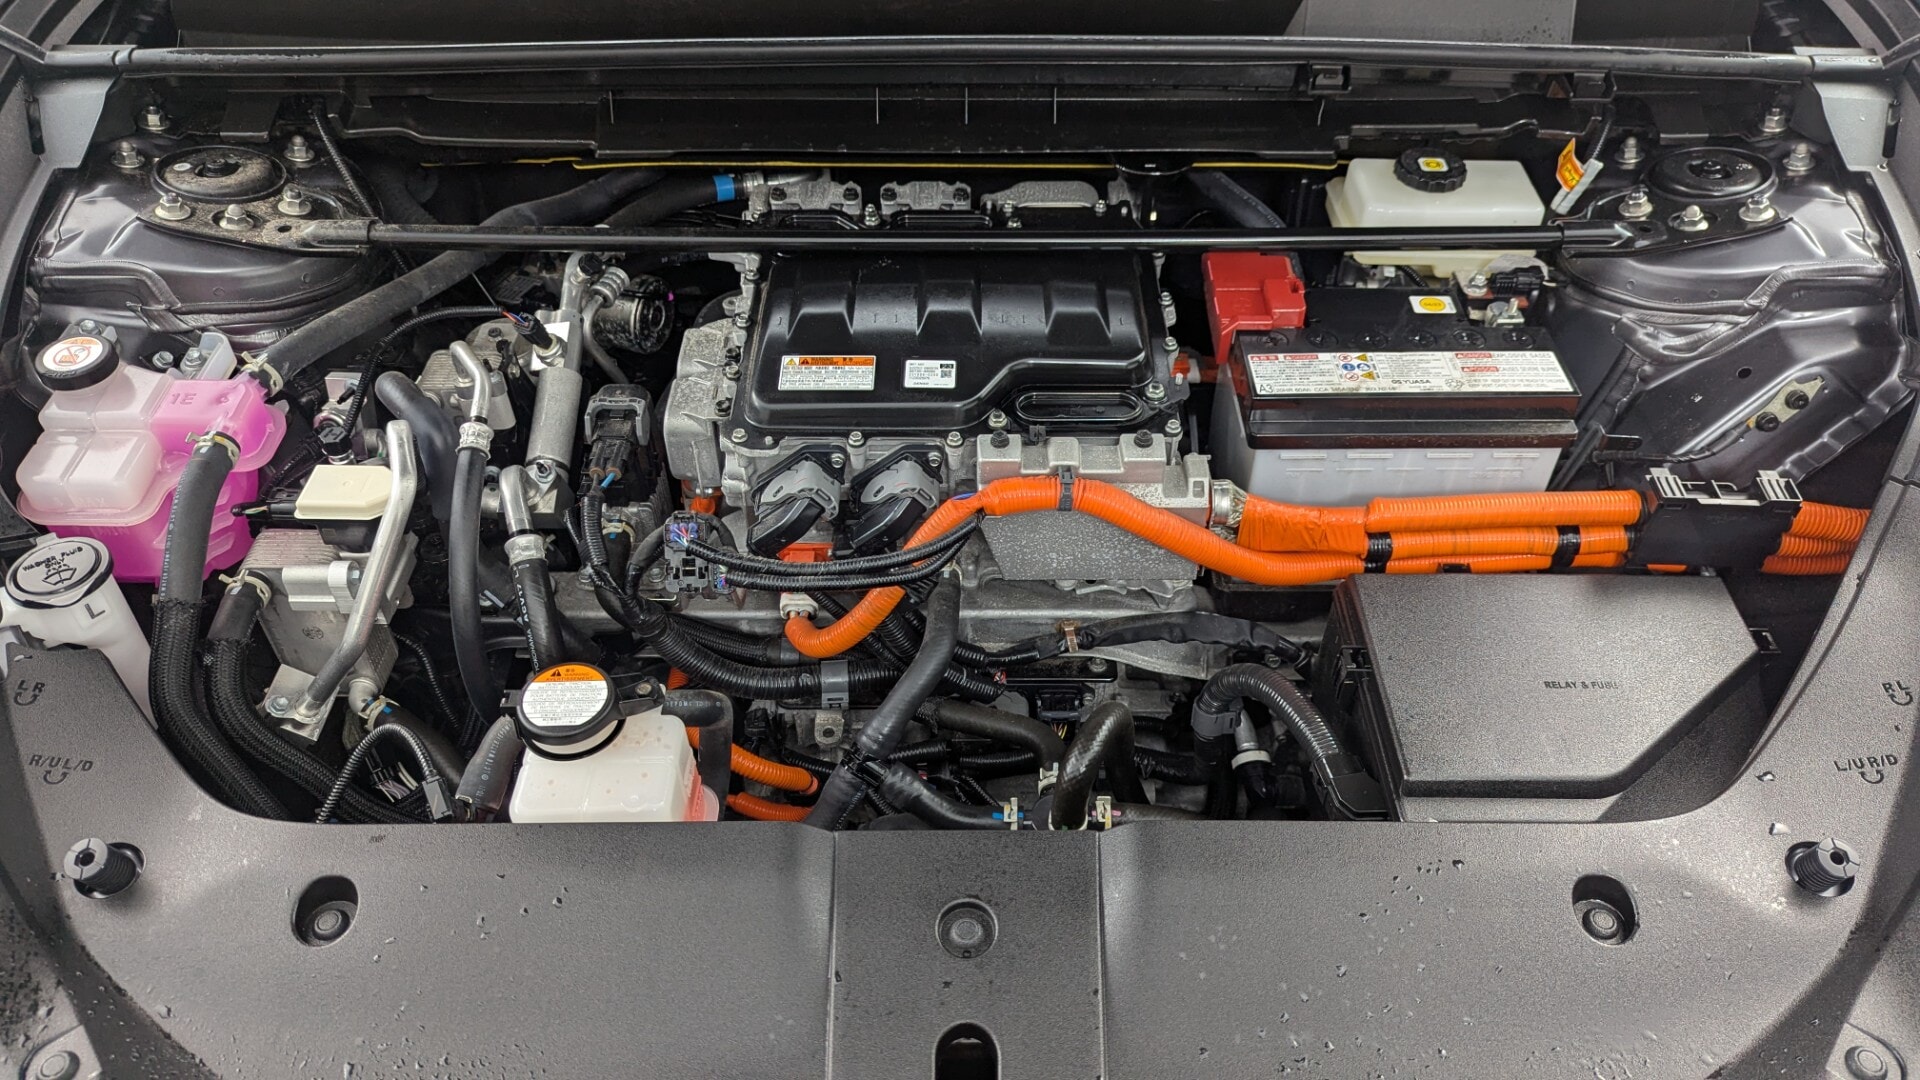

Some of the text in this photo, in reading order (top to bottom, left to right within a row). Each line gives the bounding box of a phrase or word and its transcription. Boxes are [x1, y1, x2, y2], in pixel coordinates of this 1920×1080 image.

[1259, 384, 1273, 393] A3
[516, 583, 529, 623] ACV17
[1544, 681, 1577, 689] RELAY
[1581, 681, 1590, 689] &
